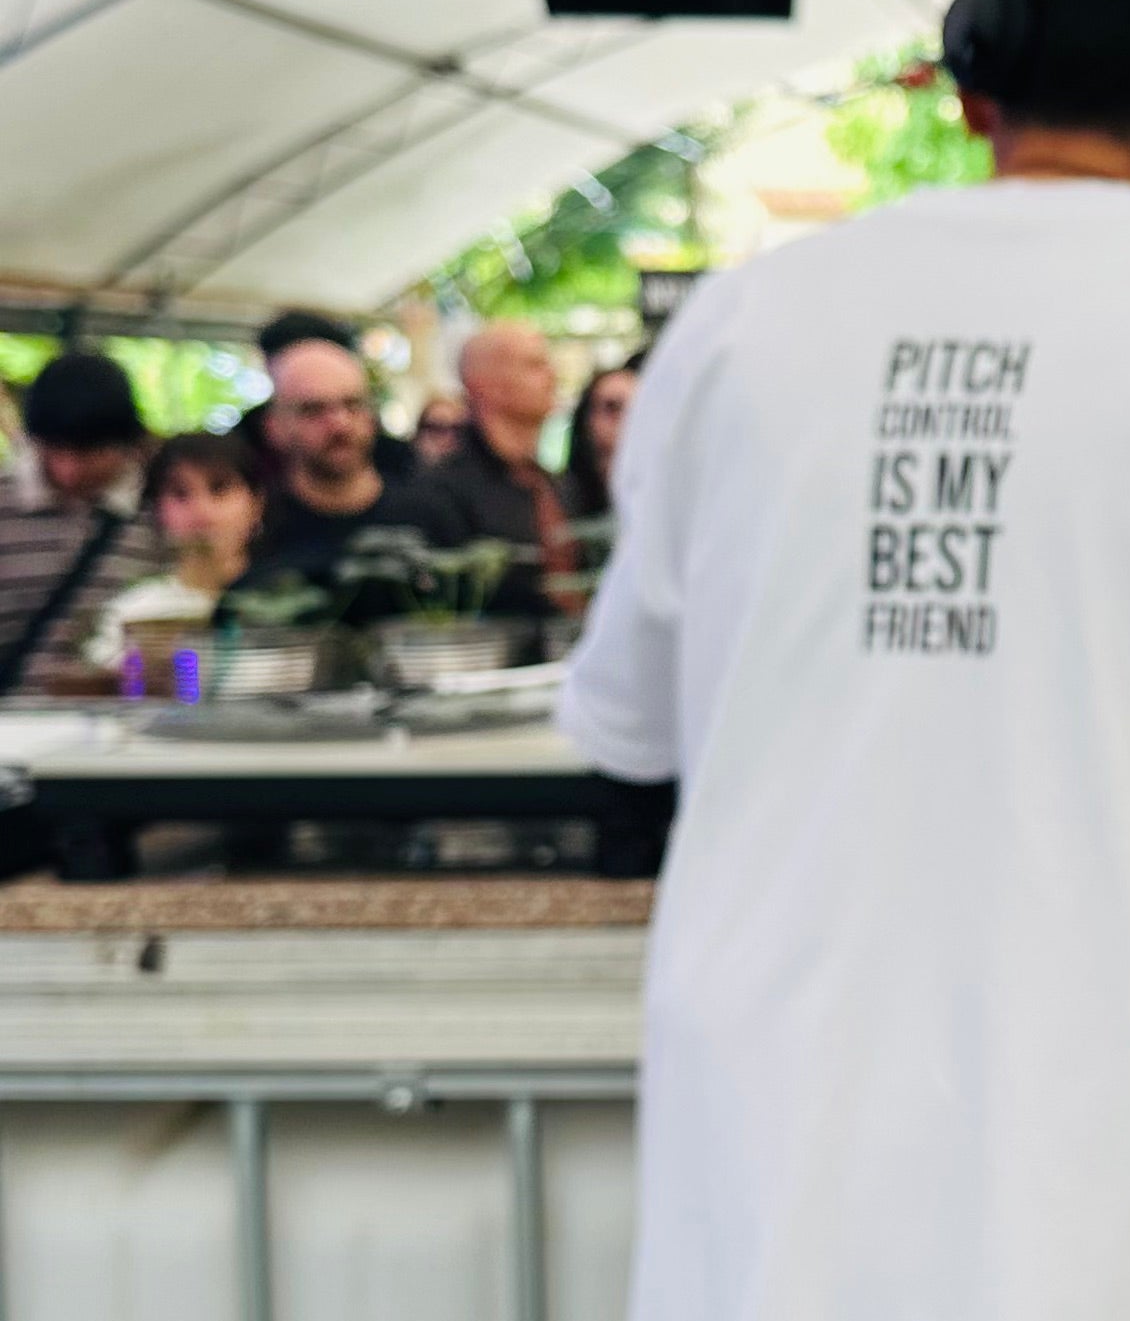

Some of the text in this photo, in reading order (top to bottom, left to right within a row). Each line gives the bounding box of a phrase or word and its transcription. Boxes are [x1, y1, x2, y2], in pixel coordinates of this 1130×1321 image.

[884, 339, 1030, 394] PITCH
[877, 402, 1011, 440] CONTROL
[870, 450, 1011, 515] IS MY
[866, 522, 1002, 594] BEST
[862, 601, 998, 655] FRIEND
